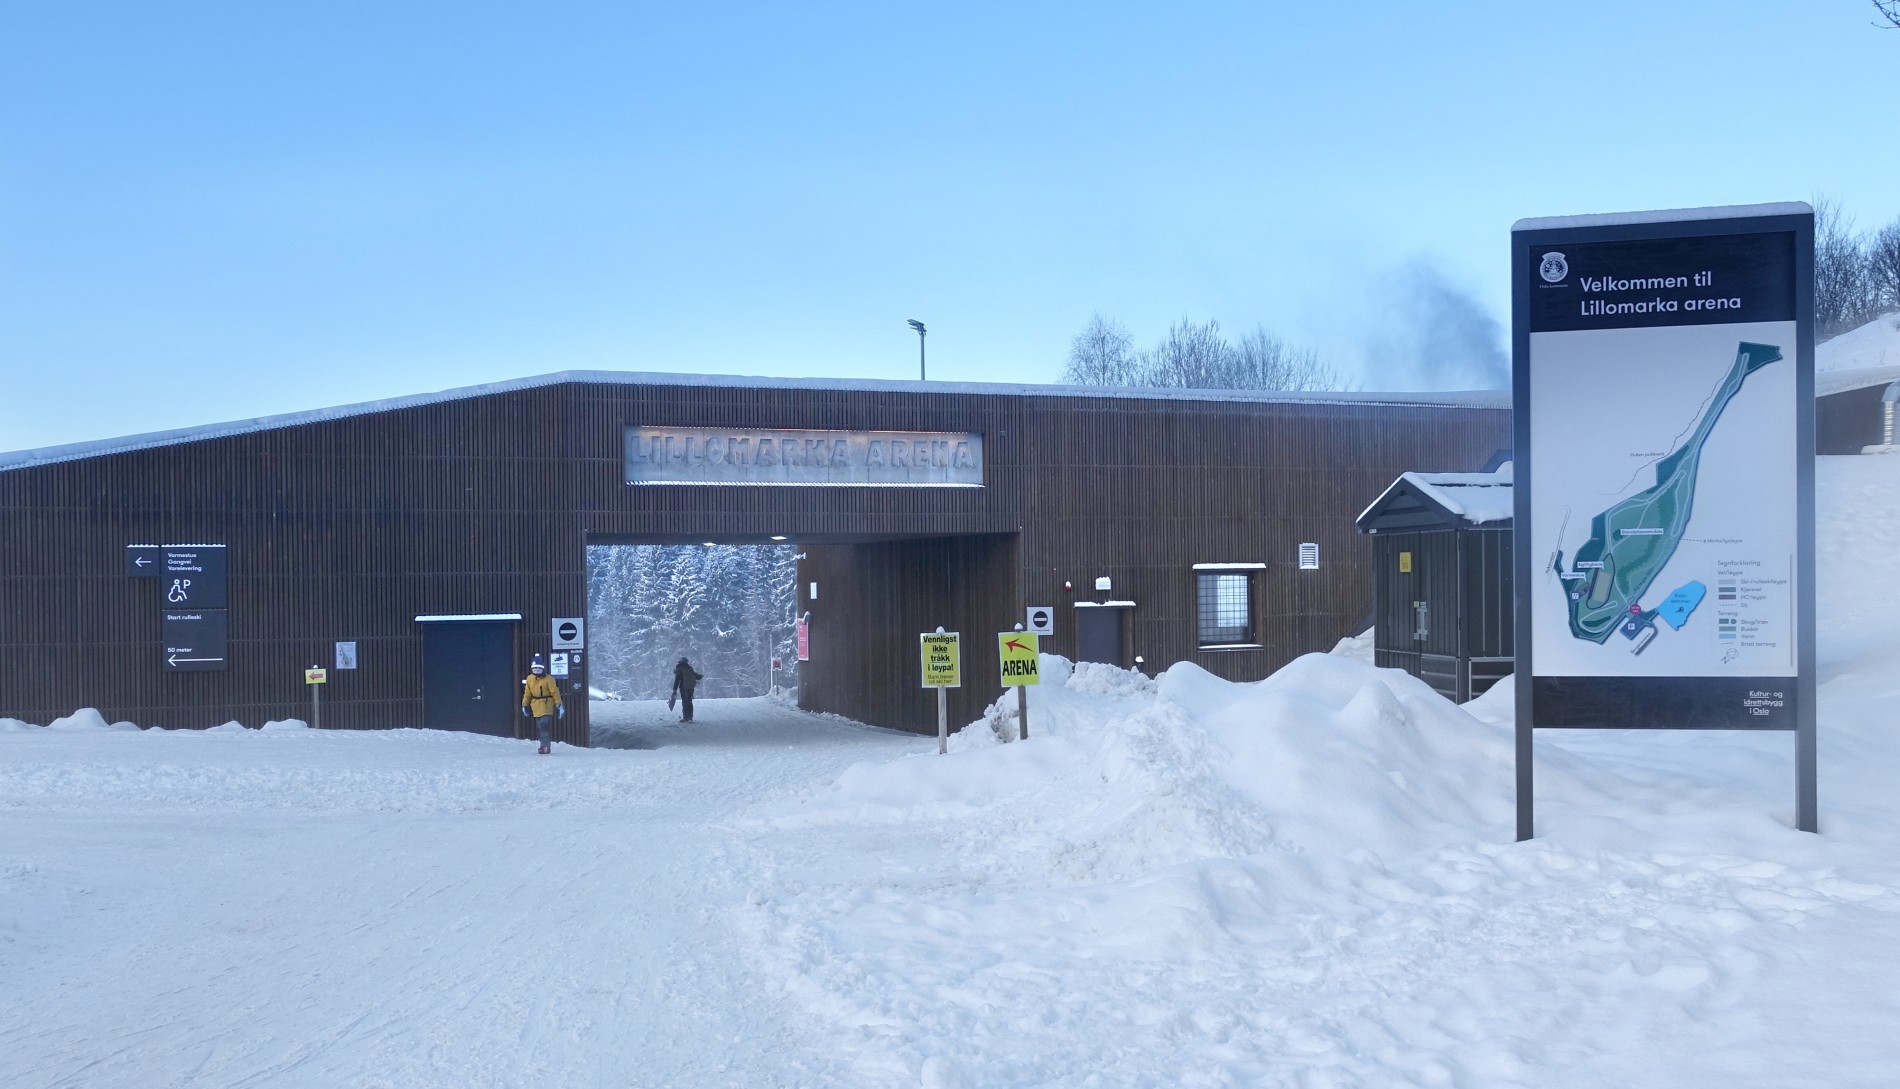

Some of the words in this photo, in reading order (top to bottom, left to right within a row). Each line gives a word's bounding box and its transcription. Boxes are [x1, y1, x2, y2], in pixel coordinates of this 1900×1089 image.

[1580, 276, 1688, 292] Velkommen
[1694, 271, 1712, 287] til
[1581, 297, 1678, 316] Lillomarka
[1684, 297, 1741, 311] arena
[629, 436, 852, 468] LILLOMARKA
[865, 440, 976, 469] ARENA
[183, 580, 191, 589] P
[922, 635, 957, 645] Vennligst
[932, 645, 948, 653] ikke
[932, 663, 954, 672] løypa!
[1002, 659, 1037, 676] ARENA
